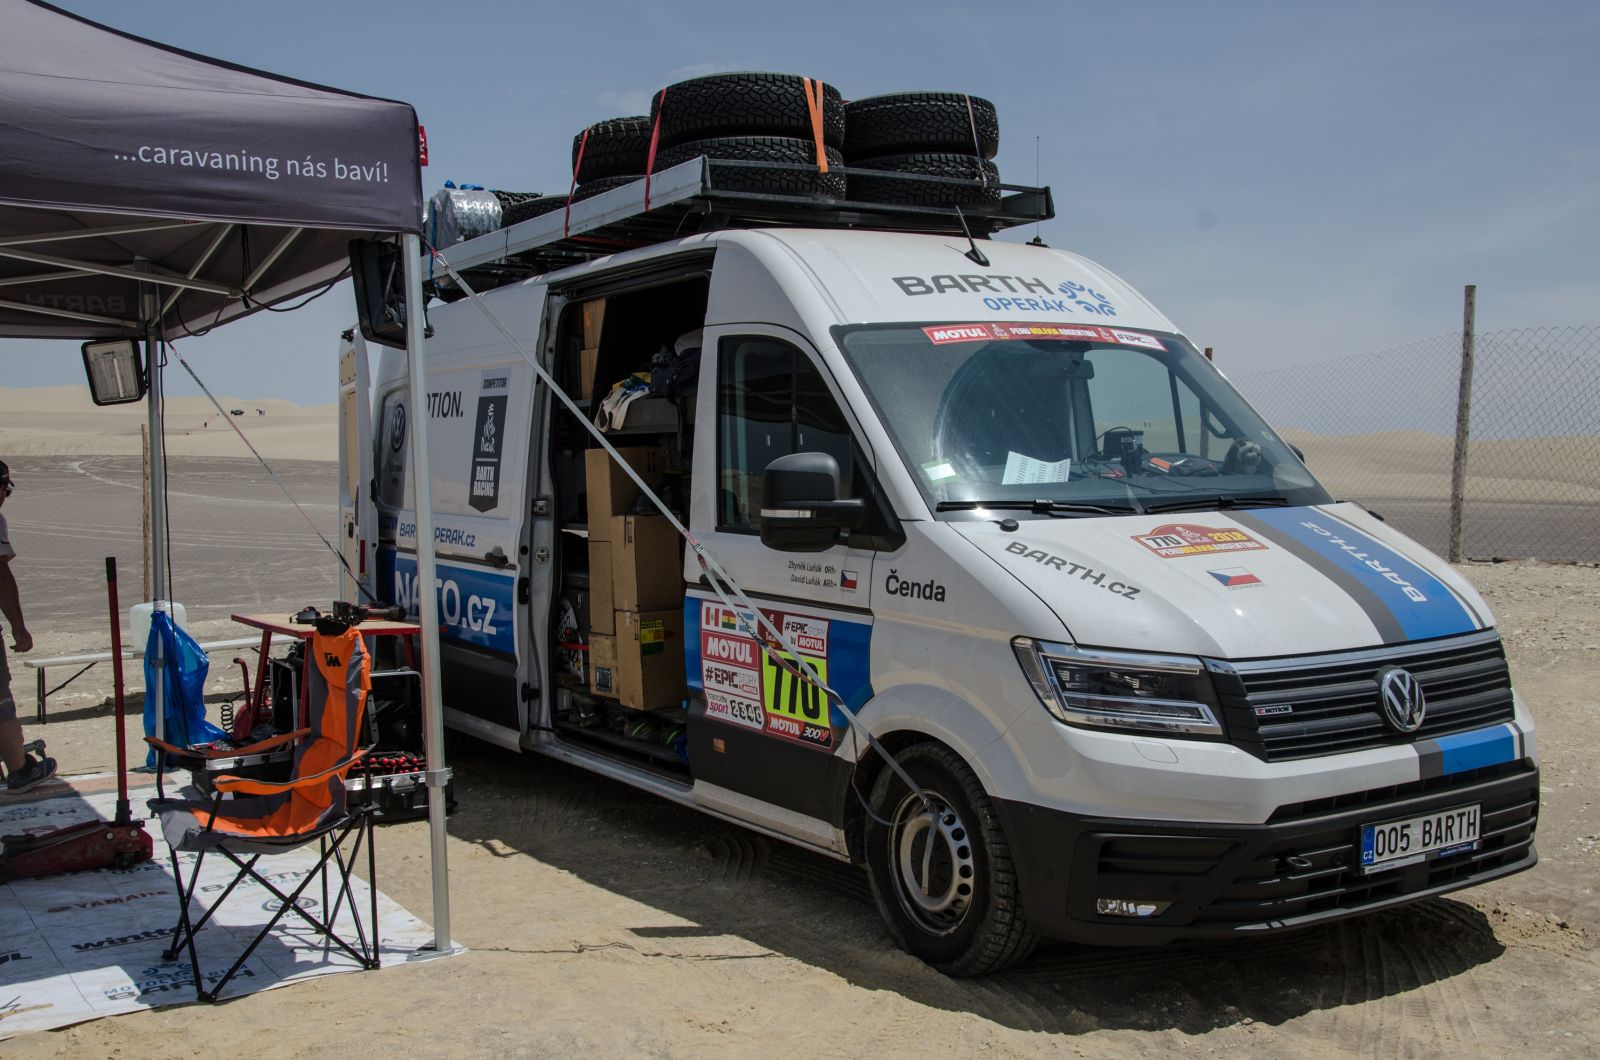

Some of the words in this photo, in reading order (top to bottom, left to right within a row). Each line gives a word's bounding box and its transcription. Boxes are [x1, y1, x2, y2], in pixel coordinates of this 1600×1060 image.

[287, 155, 327, 178] nás
[335, 158, 388, 182] baví!
[892, 273, 1056, 296] BARTH
[982, 295, 1074, 313] OPERÁK
[933, 327, 987, 341] MOTUL
[427, 391, 464, 418] TION.
[476, 465, 495, 481] BARTH
[473, 481, 494, 497] RACING
[1146, 535, 1183, 548] 770
[1207, 531, 1249, 542] 2018
[791, 574, 805, 584] David
[885, 568, 946, 602] Čenda
[706, 636, 753, 664] MOTUL
[798, 636, 824, 650] MOTUL
[767, 654, 820, 720] 770
[770, 716, 801, 736] MOTUL
[803, 727, 829, 742] 300V
[1375, 823, 1411, 857] 005
[1422, 809, 1477, 848] BARTH
[1362, 850, 1373, 860] CZ
